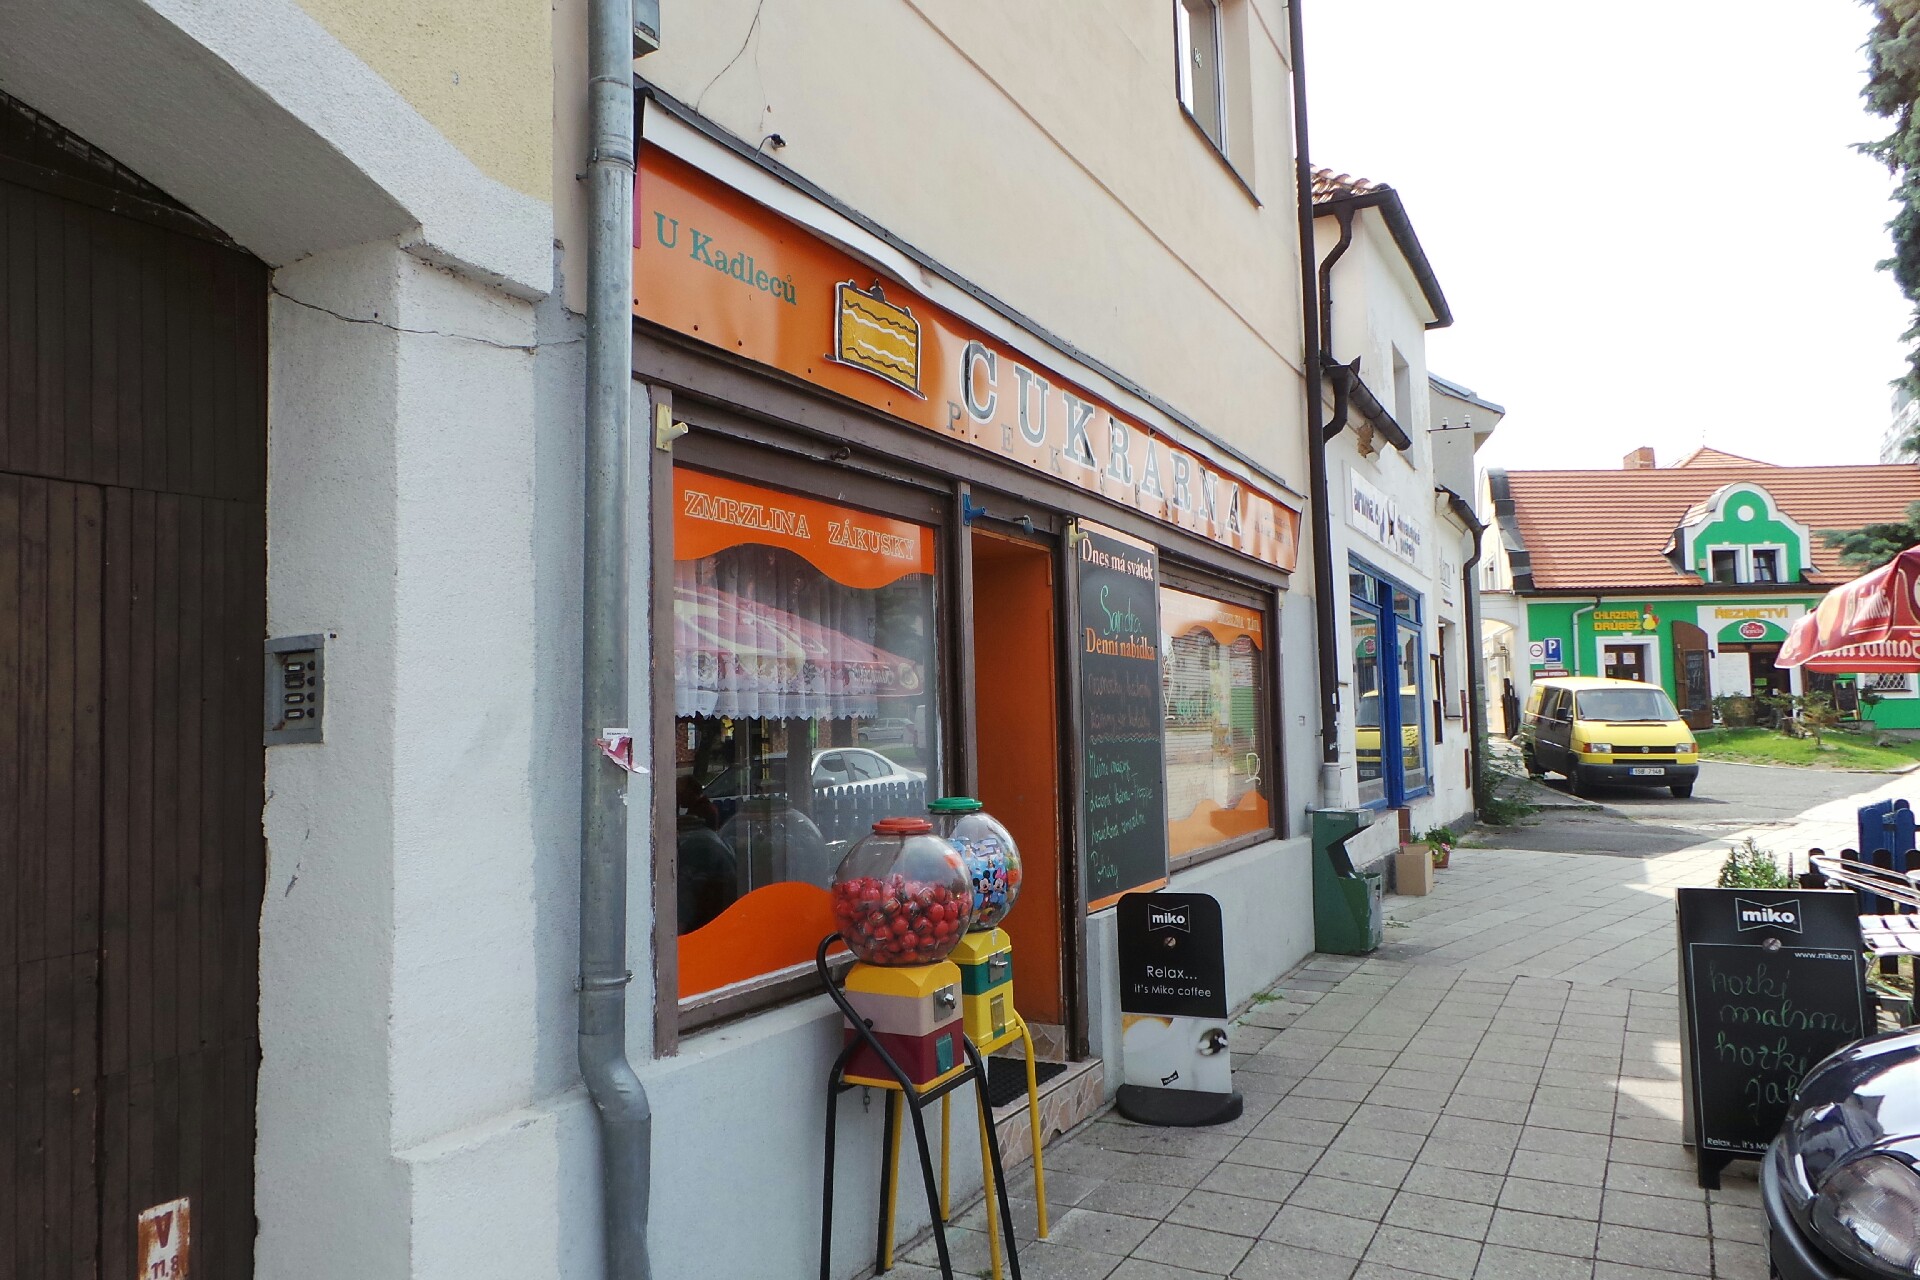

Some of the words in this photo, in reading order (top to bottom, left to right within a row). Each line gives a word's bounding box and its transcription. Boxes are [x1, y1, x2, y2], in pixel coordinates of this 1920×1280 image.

[653, 210, 679, 249] U
[690, 227, 797, 305] Kadleců
[684, 490, 810, 538] ZMRZLINA
[828, 518, 915, 560] ZÁKUSKY
[1082, 538, 1109, 568] Dnes
[1111, 552, 1126, 573] má
[1128, 557, 1154, 581] svátek
[1100, 584, 1143, 636] Sandra
[1085, 627, 1118, 656] Denní
[1120, 634, 1156, 660] nabídka
[1548, 640, 1557, 654] P
[1151, 912, 1186, 925] miko
[1742, 907, 1796, 924] miko
[1794, 951, 1853, 961] www.miko.eu
[1146, 965, 1198, 980] Relax...
[1134, 984, 1149, 994] it's
[1151, 985, 1175, 996] Miko
[1177, 986, 1212, 998] coffee
[1707, 1137, 1731, 1147] Relax
[154, 1210, 174, 1249] V
